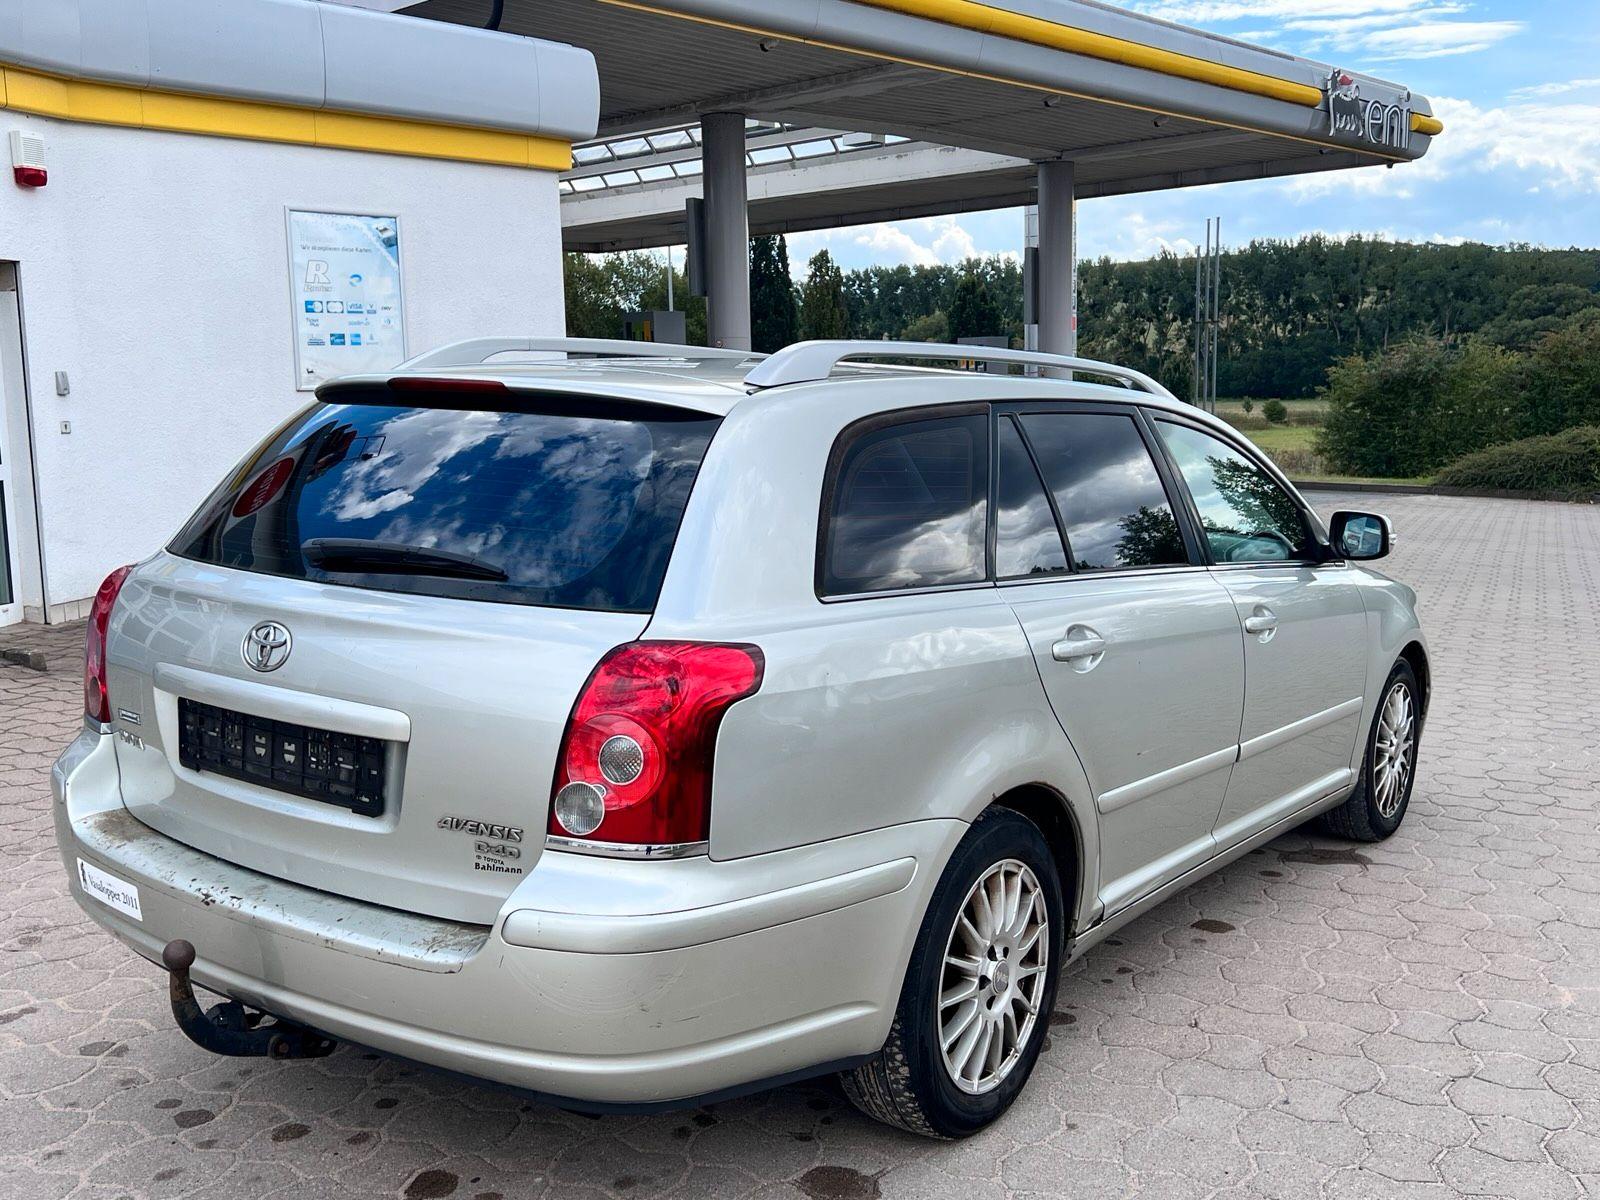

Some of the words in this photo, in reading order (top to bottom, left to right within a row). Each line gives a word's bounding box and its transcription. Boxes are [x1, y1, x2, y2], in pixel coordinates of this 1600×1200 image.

[1364, 90, 1411, 149] eni
[436, 816, 524, 843] AVENSIS
[474, 840, 521, 859] D-4D
[474, 862, 522, 874] Bahlmann
[483, 856, 505, 866] TOYOTA
[121, 891, 138, 910] 2011
